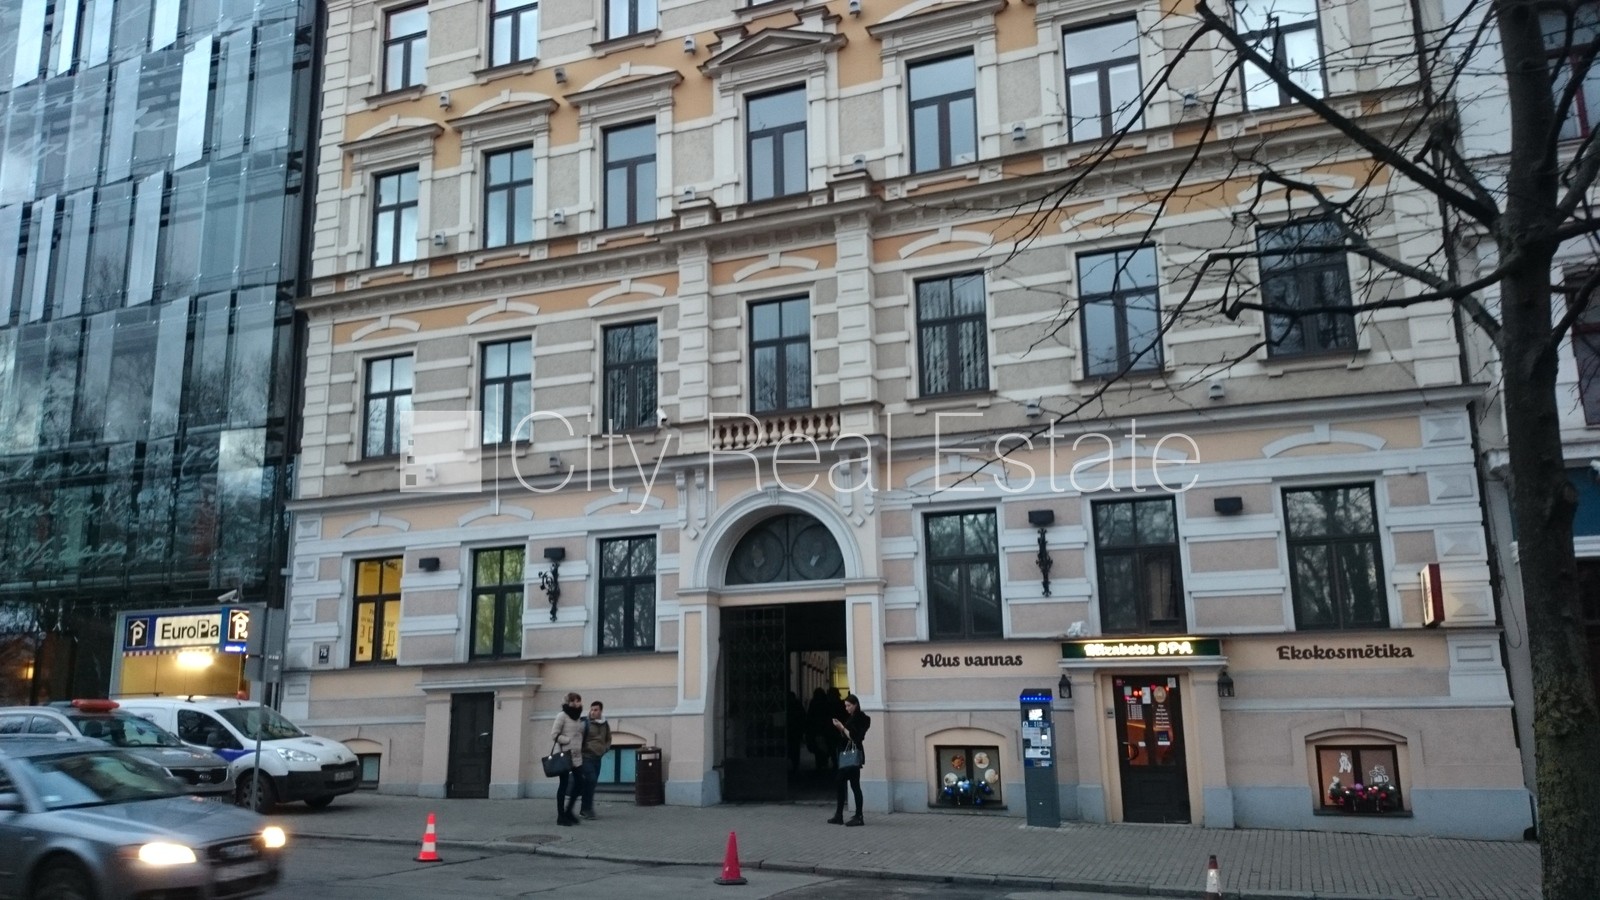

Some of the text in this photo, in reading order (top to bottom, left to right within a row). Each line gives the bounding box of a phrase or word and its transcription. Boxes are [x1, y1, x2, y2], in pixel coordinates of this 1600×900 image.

[1157, 641, 1194, 655] SPA
[1276, 643, 1415, 661] Ekokosmētika
[921, 653, 1024, 668] Alus vannas
